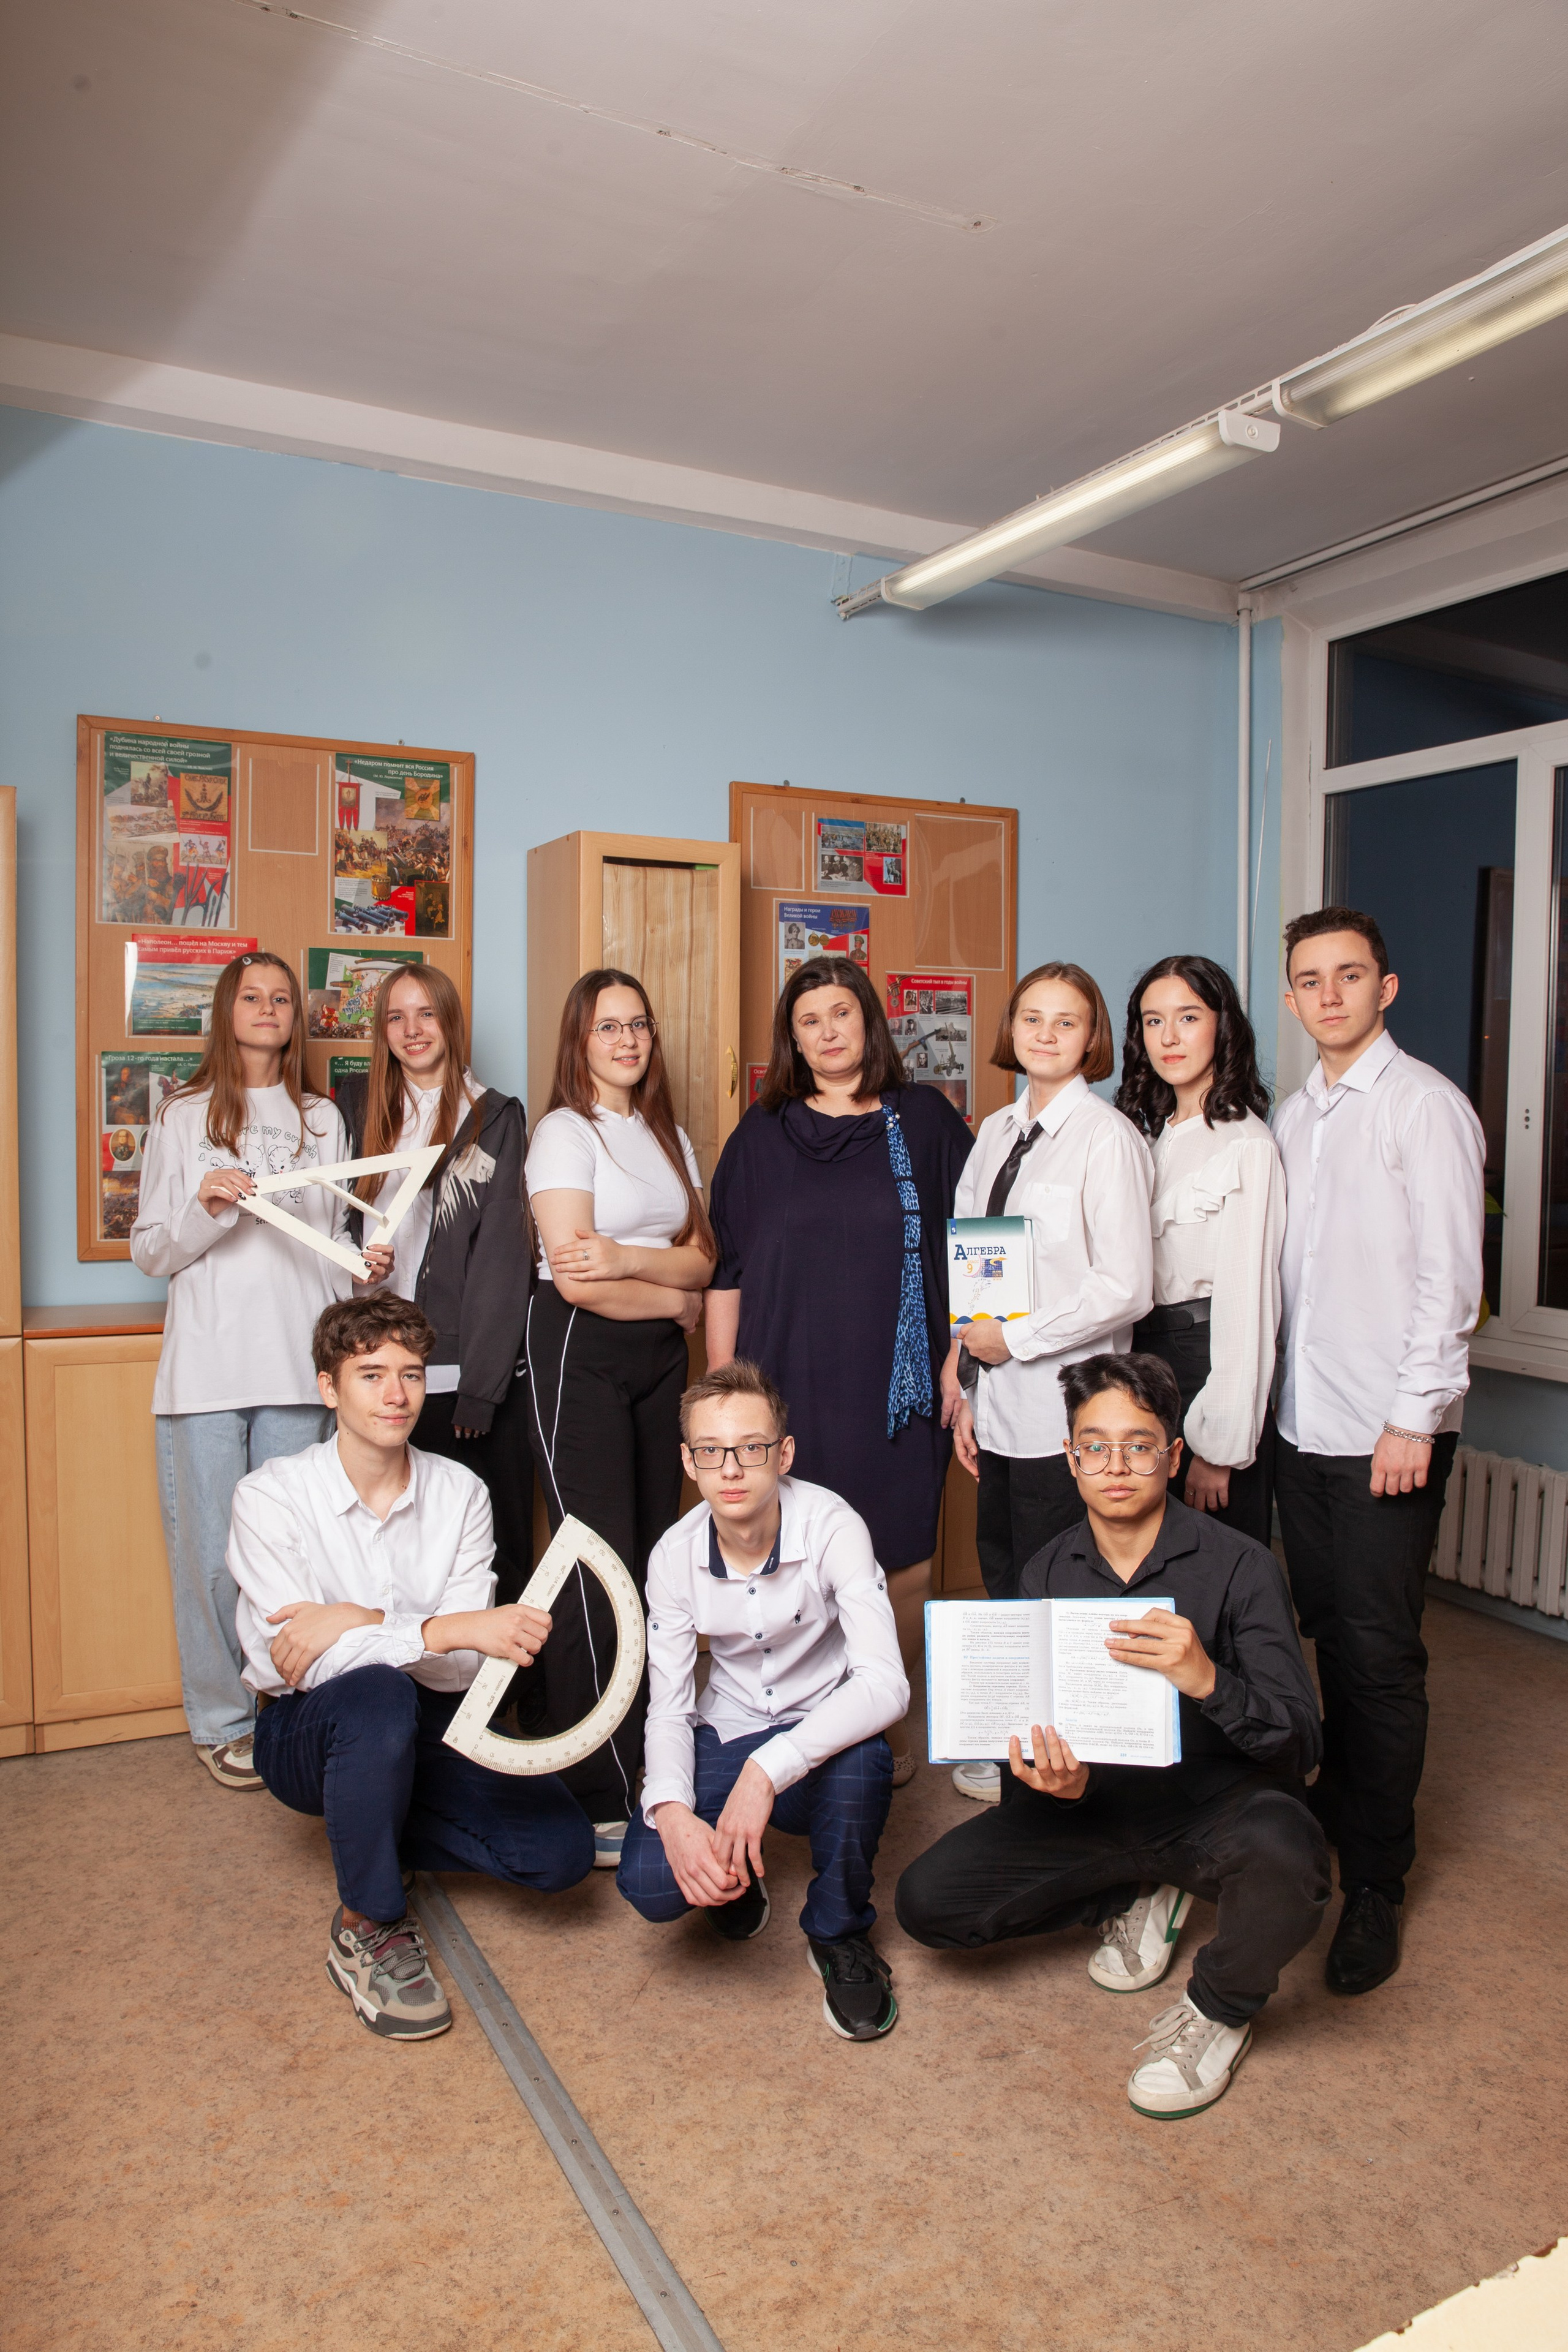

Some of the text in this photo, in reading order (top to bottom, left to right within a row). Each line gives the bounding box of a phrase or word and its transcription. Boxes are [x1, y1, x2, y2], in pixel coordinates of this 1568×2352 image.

[115, 752, 165, 761] величественной
[262, 1126, 282, 1139] my
[954, 1244, 1006, 1260] АЛГЕБРА
[967, 1264, 973, 1273] 9
